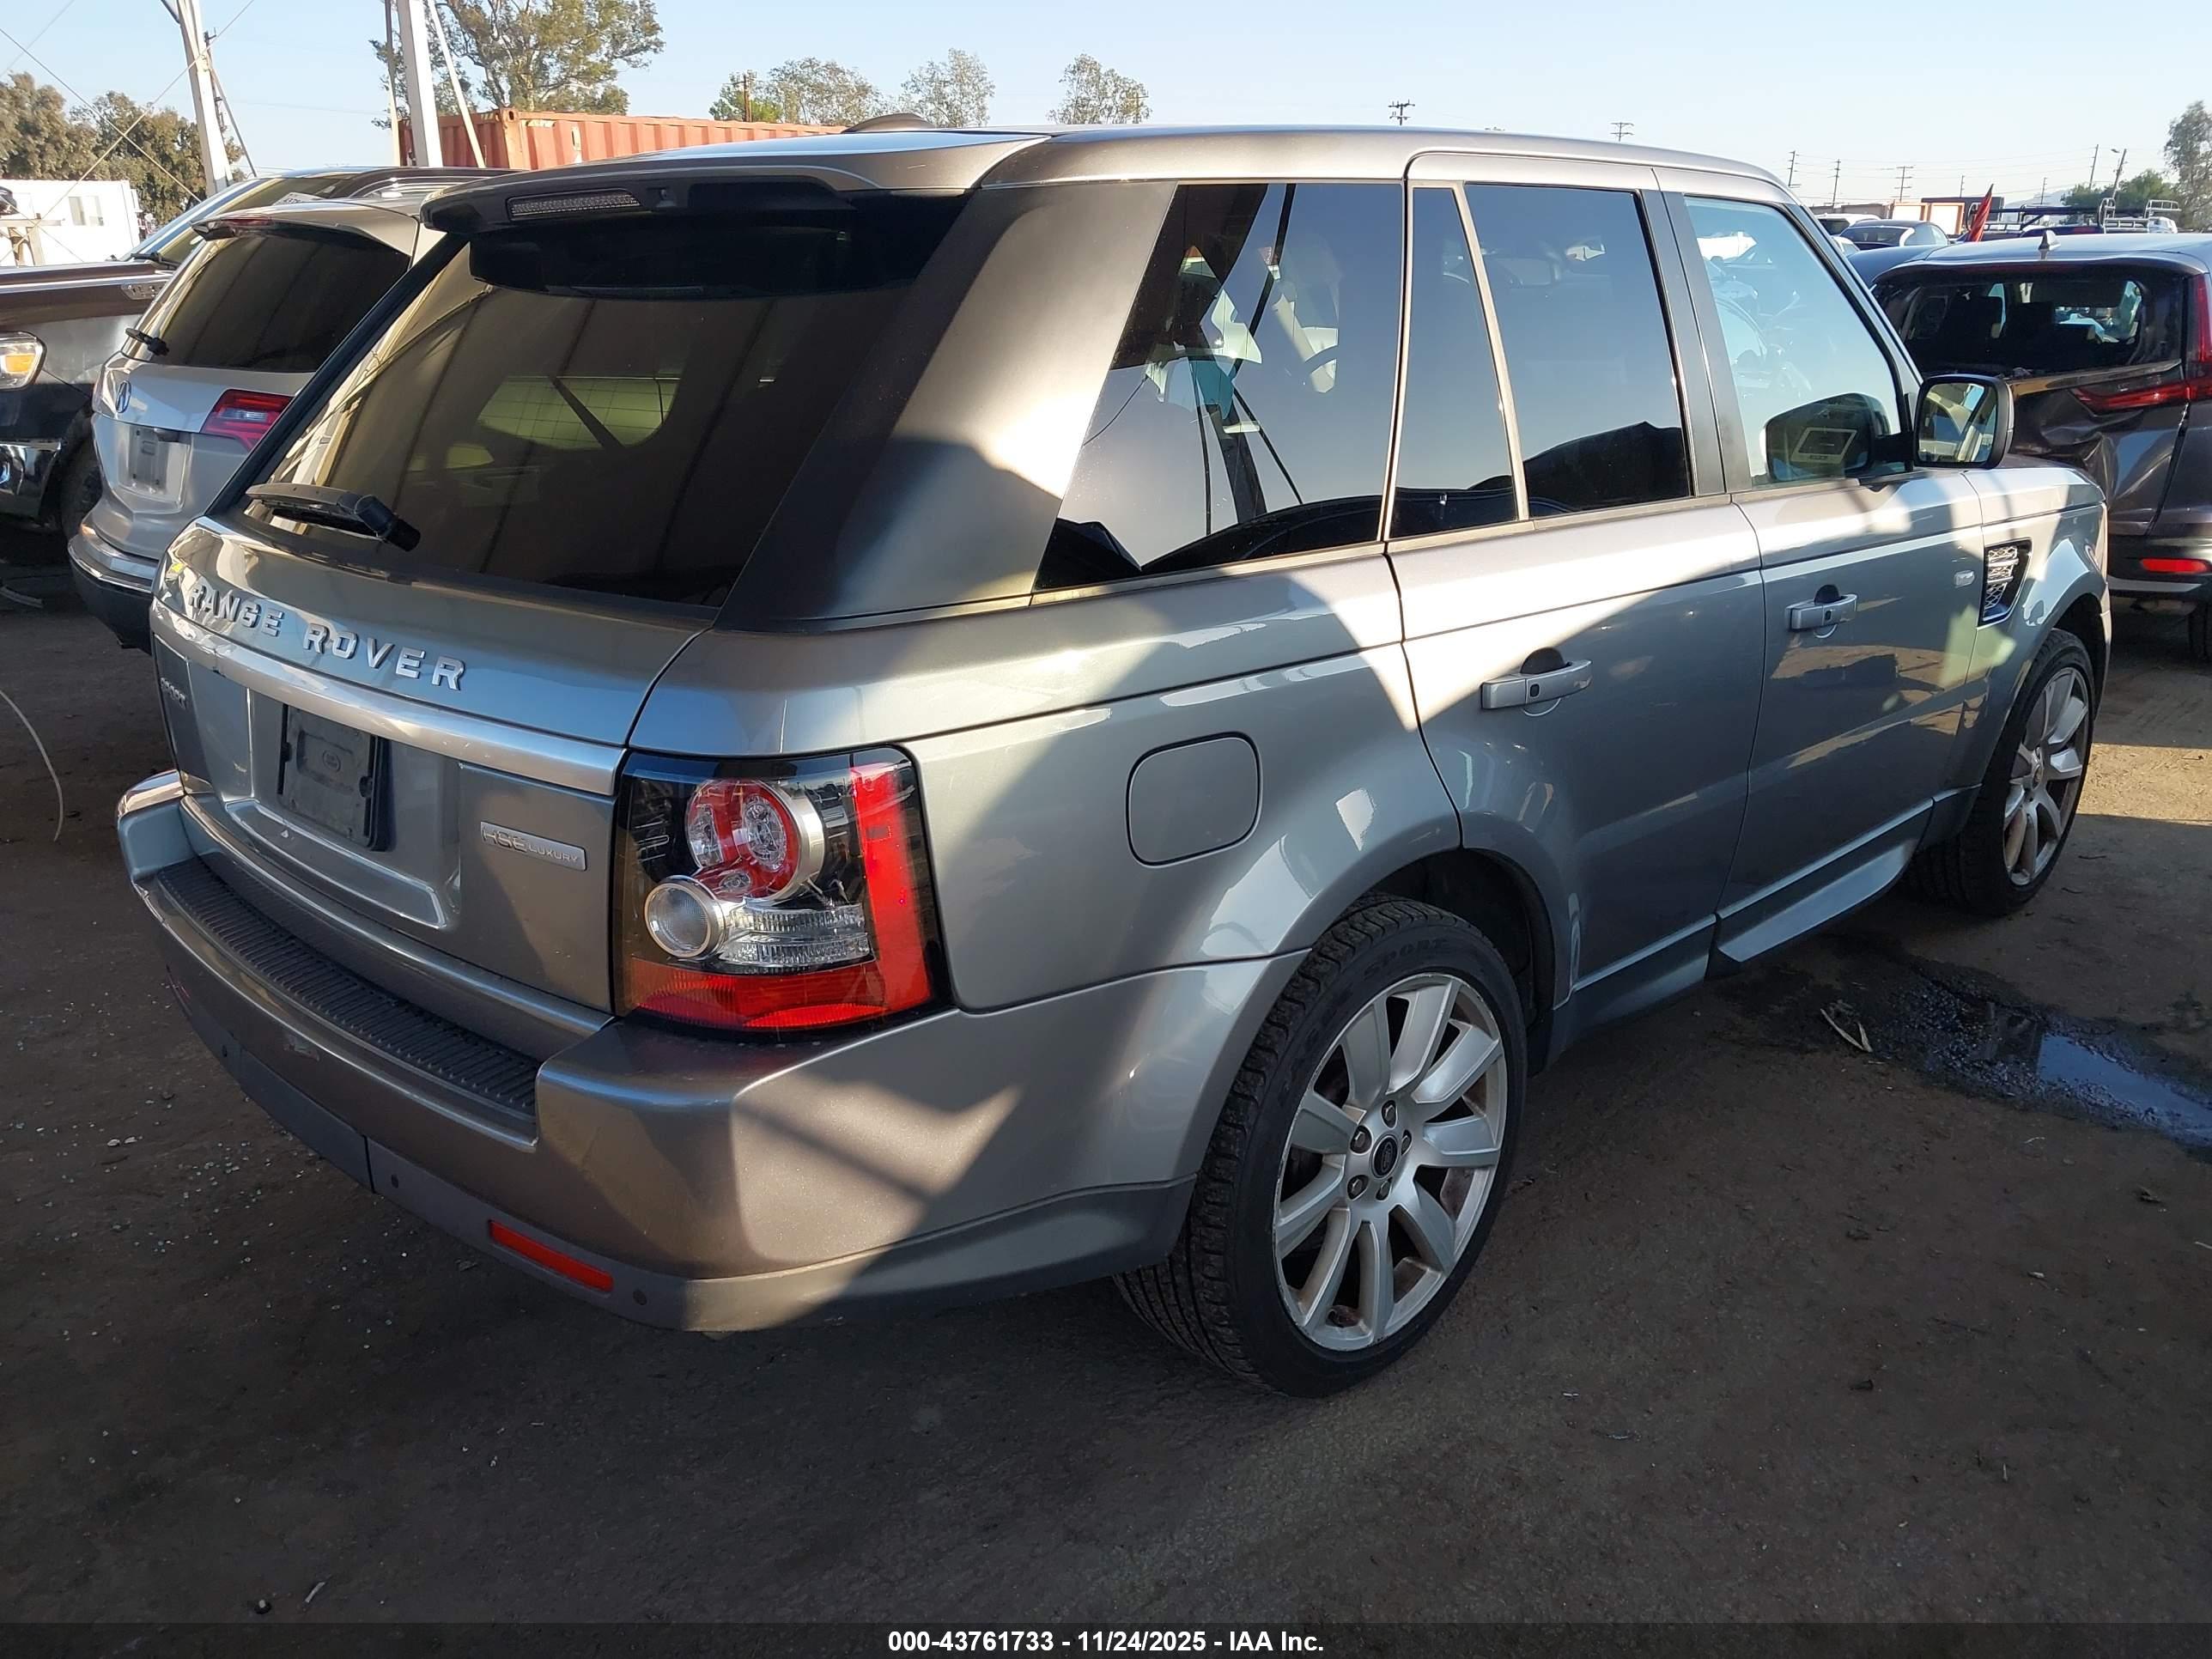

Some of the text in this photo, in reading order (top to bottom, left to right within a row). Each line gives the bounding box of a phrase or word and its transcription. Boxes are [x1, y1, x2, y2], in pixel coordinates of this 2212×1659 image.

[189, 584, 465, 691] RANGE ROVER
[481, 828, 578, 862] HSE LUXURY
